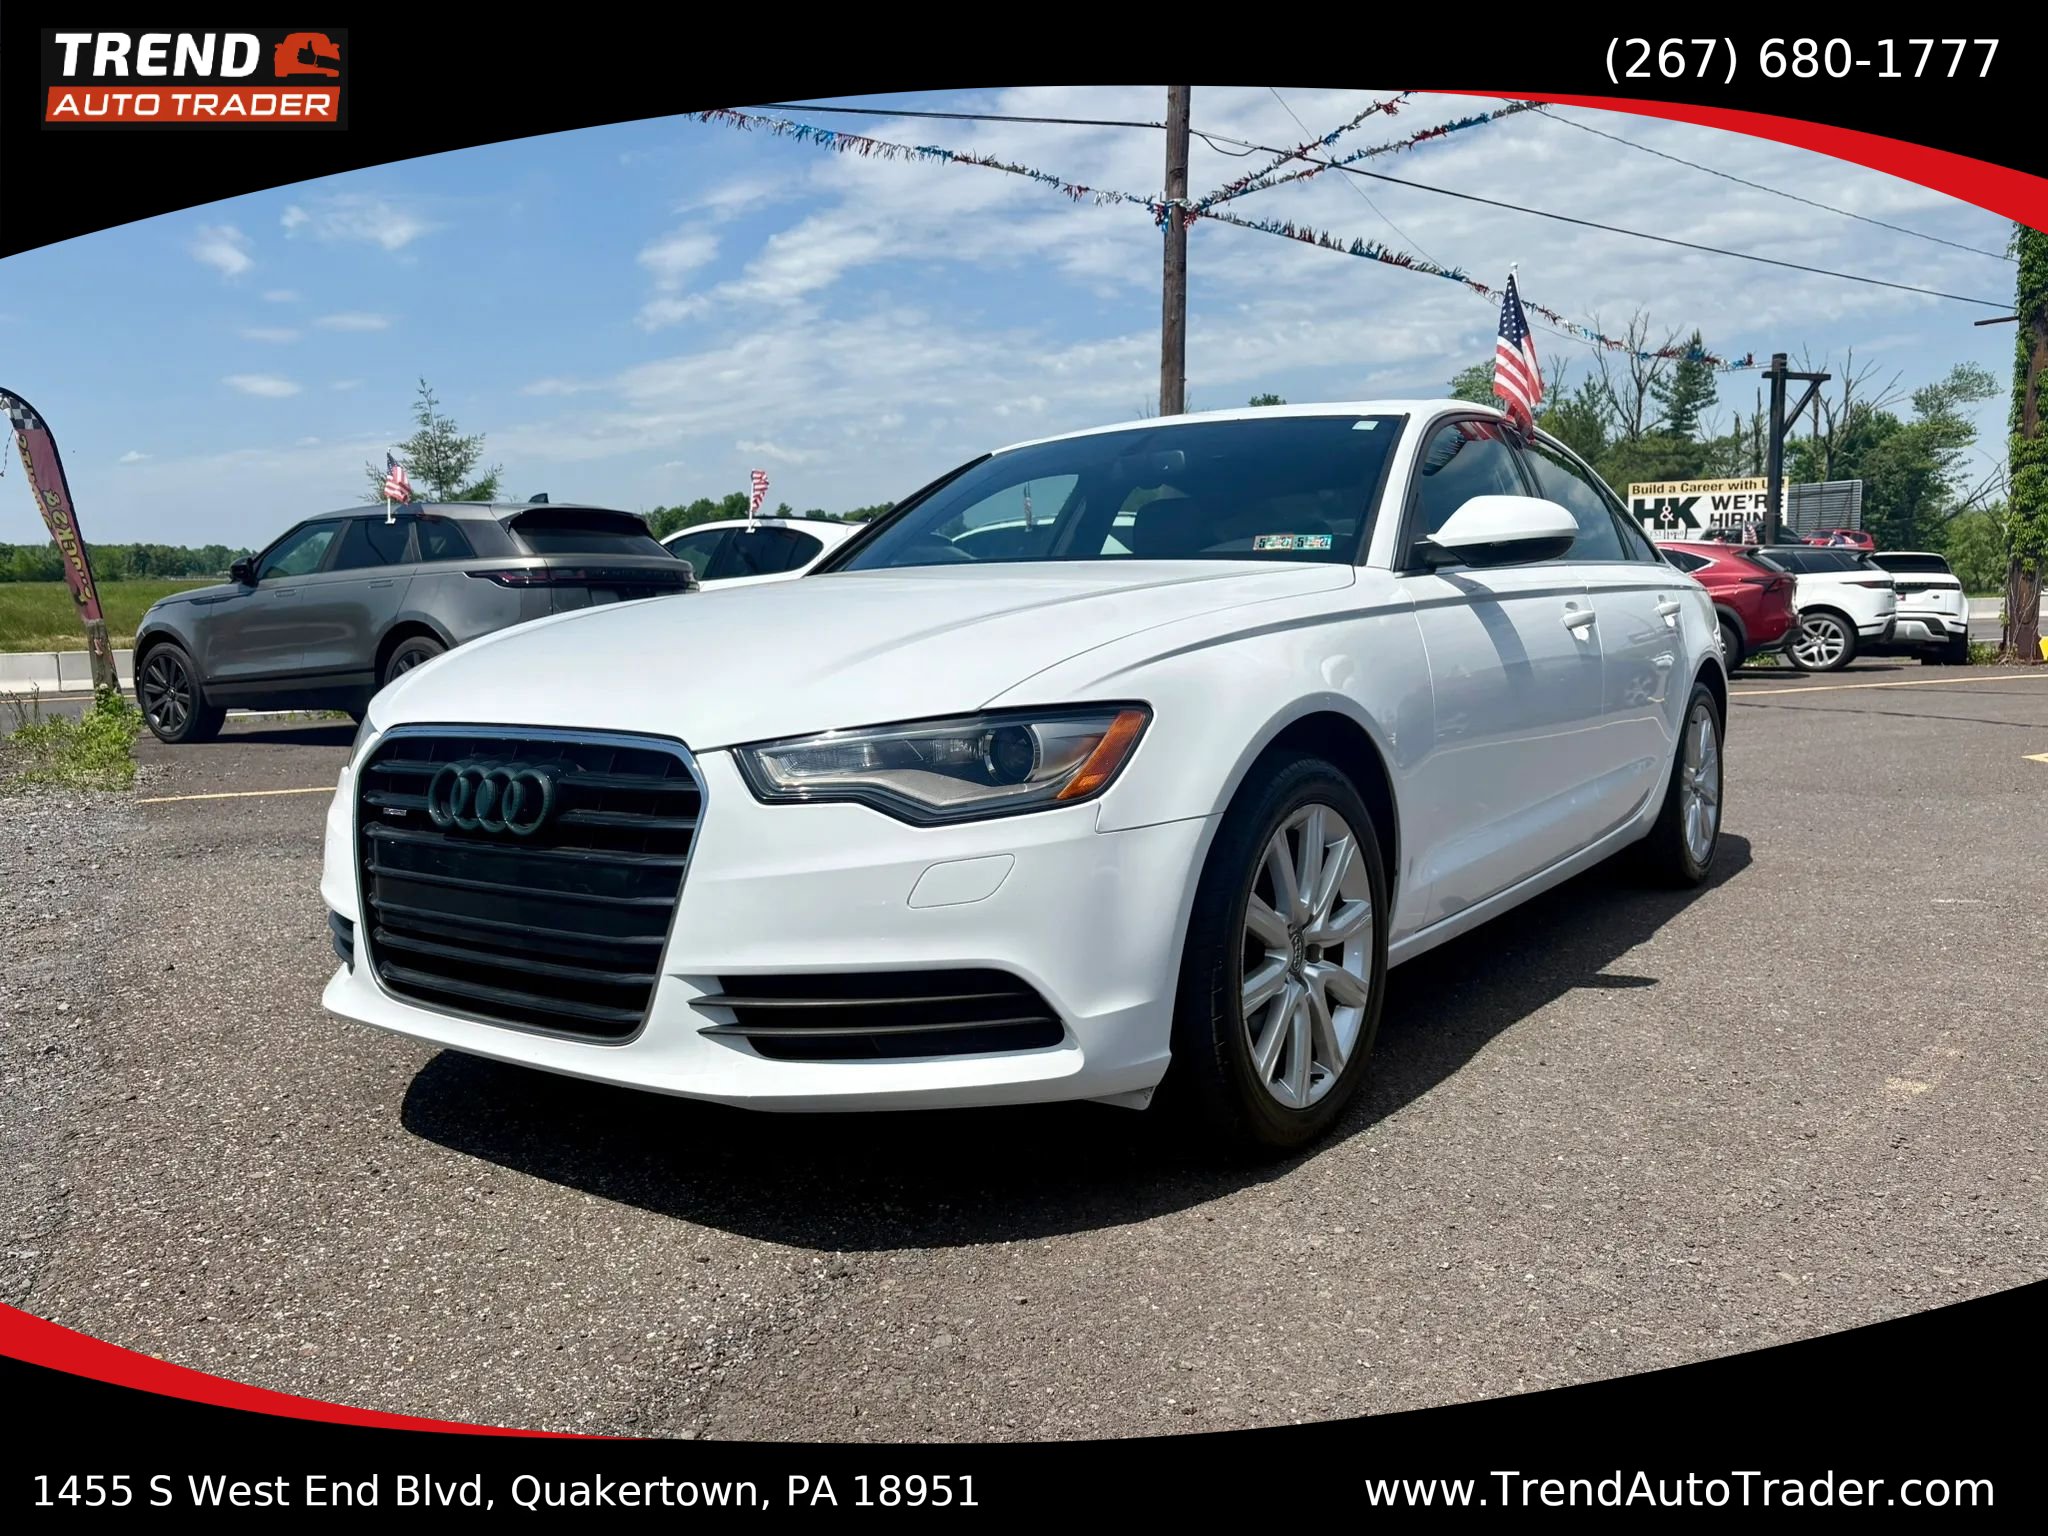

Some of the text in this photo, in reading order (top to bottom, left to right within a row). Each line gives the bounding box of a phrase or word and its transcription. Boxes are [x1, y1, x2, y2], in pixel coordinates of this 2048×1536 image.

[1632, 484, 1665, 495] Build
[1680, 482, 1723, 493] Career
[1728, 480, 1757, 491] with
[1711, 493, 1784, 511] WE'R
[1633, 496, 1703, 530] H&K
